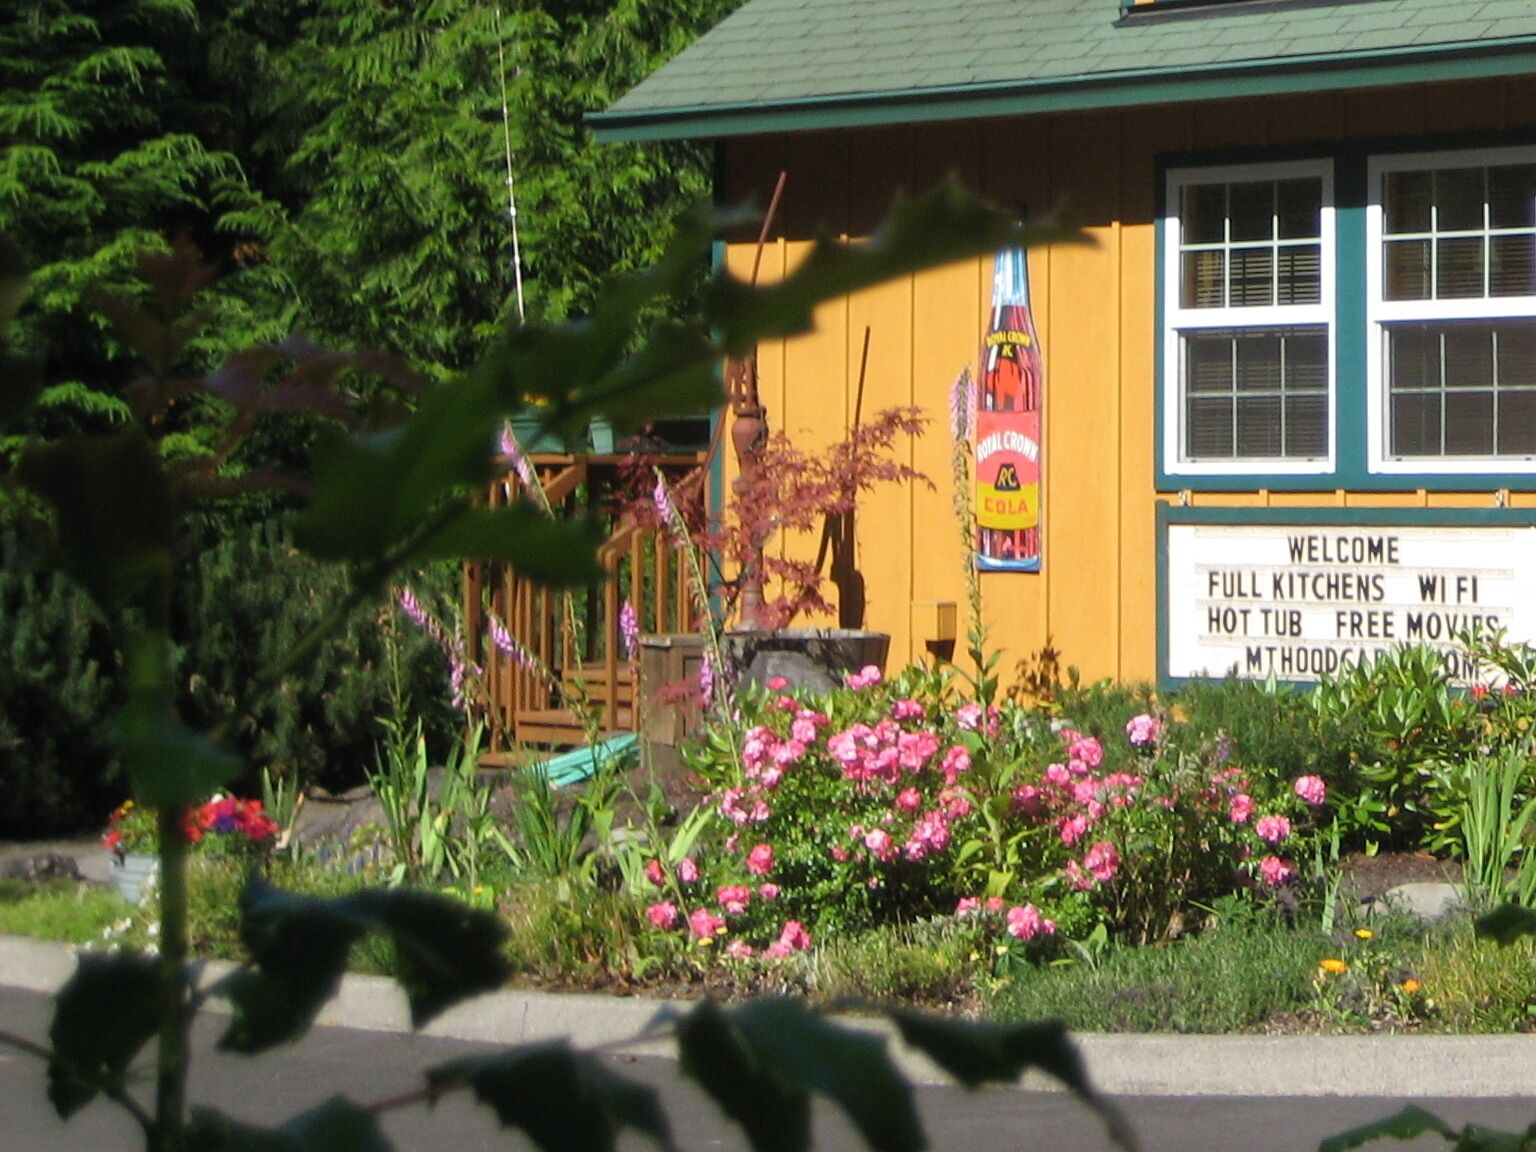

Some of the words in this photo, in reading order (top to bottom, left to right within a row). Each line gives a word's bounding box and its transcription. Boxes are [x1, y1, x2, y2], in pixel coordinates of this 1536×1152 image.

[977, 431, 1002, 464] ROYAL
[1003, 430, 1039, 462] CROWN
[984, 497, 1028, 516] COLA
[1288, 535, 1400, 564] WELCOME
[1209, 570, 1262, 598] FULL
[1272, 572, 1385, 602] KITCHENS
[1208, 607, 1253, 635] HOT
[1261, 608, 1302, 637] TUB
[1336, 611, 1395, 639] FREE
